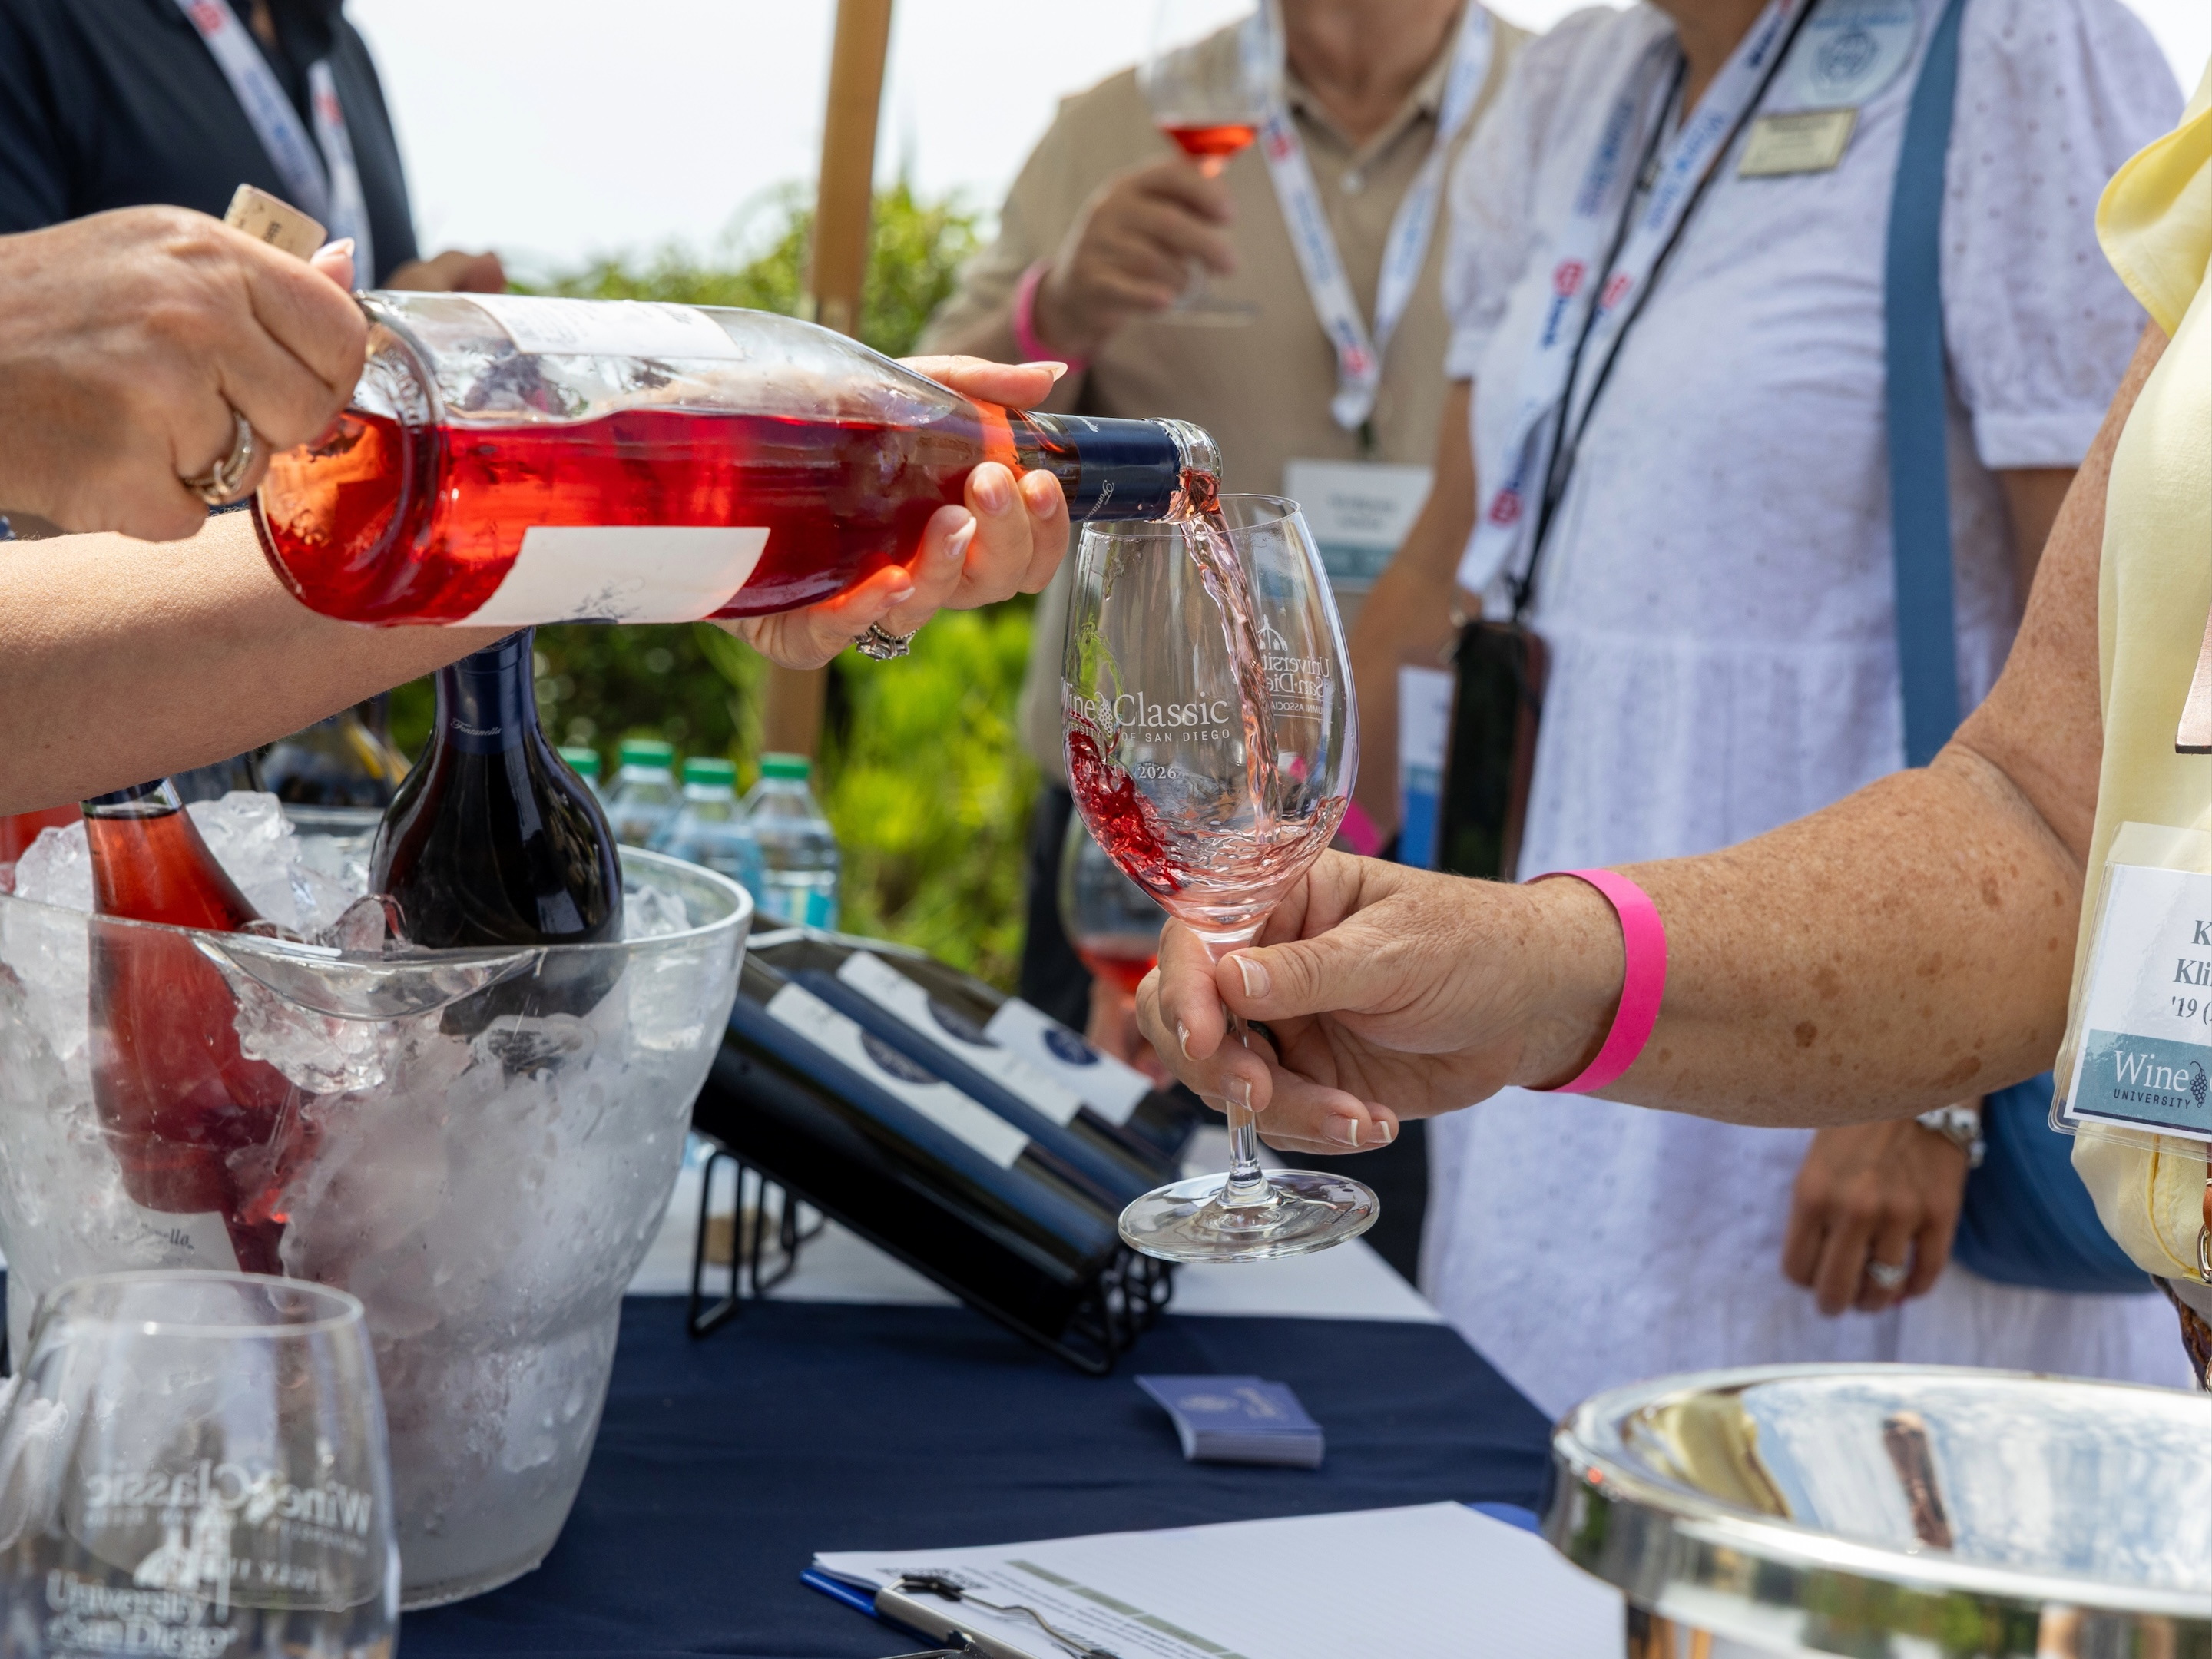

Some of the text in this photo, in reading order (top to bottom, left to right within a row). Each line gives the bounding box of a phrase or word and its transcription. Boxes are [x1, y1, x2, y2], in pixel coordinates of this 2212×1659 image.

[1081, 479, 1115, 522] Fontanell
[1113, 690, 1230, 727] Classic
[450, 717, 502, 736] Fontanella
[1121, 731, 1137, 742] OF
[1144, 732, 1173, 743] SAN
[1182, 729, 1230, 743] DIEGO
[1137, 766, 1177, 780] 2026
[2172, 958, 2212, 987] Kli
[2171, 995, 2198, 1018] '19
[2114, 1049, 2189, 1092] Wine
[2114, 1088, 2191, 1109] UNIVERSITY
